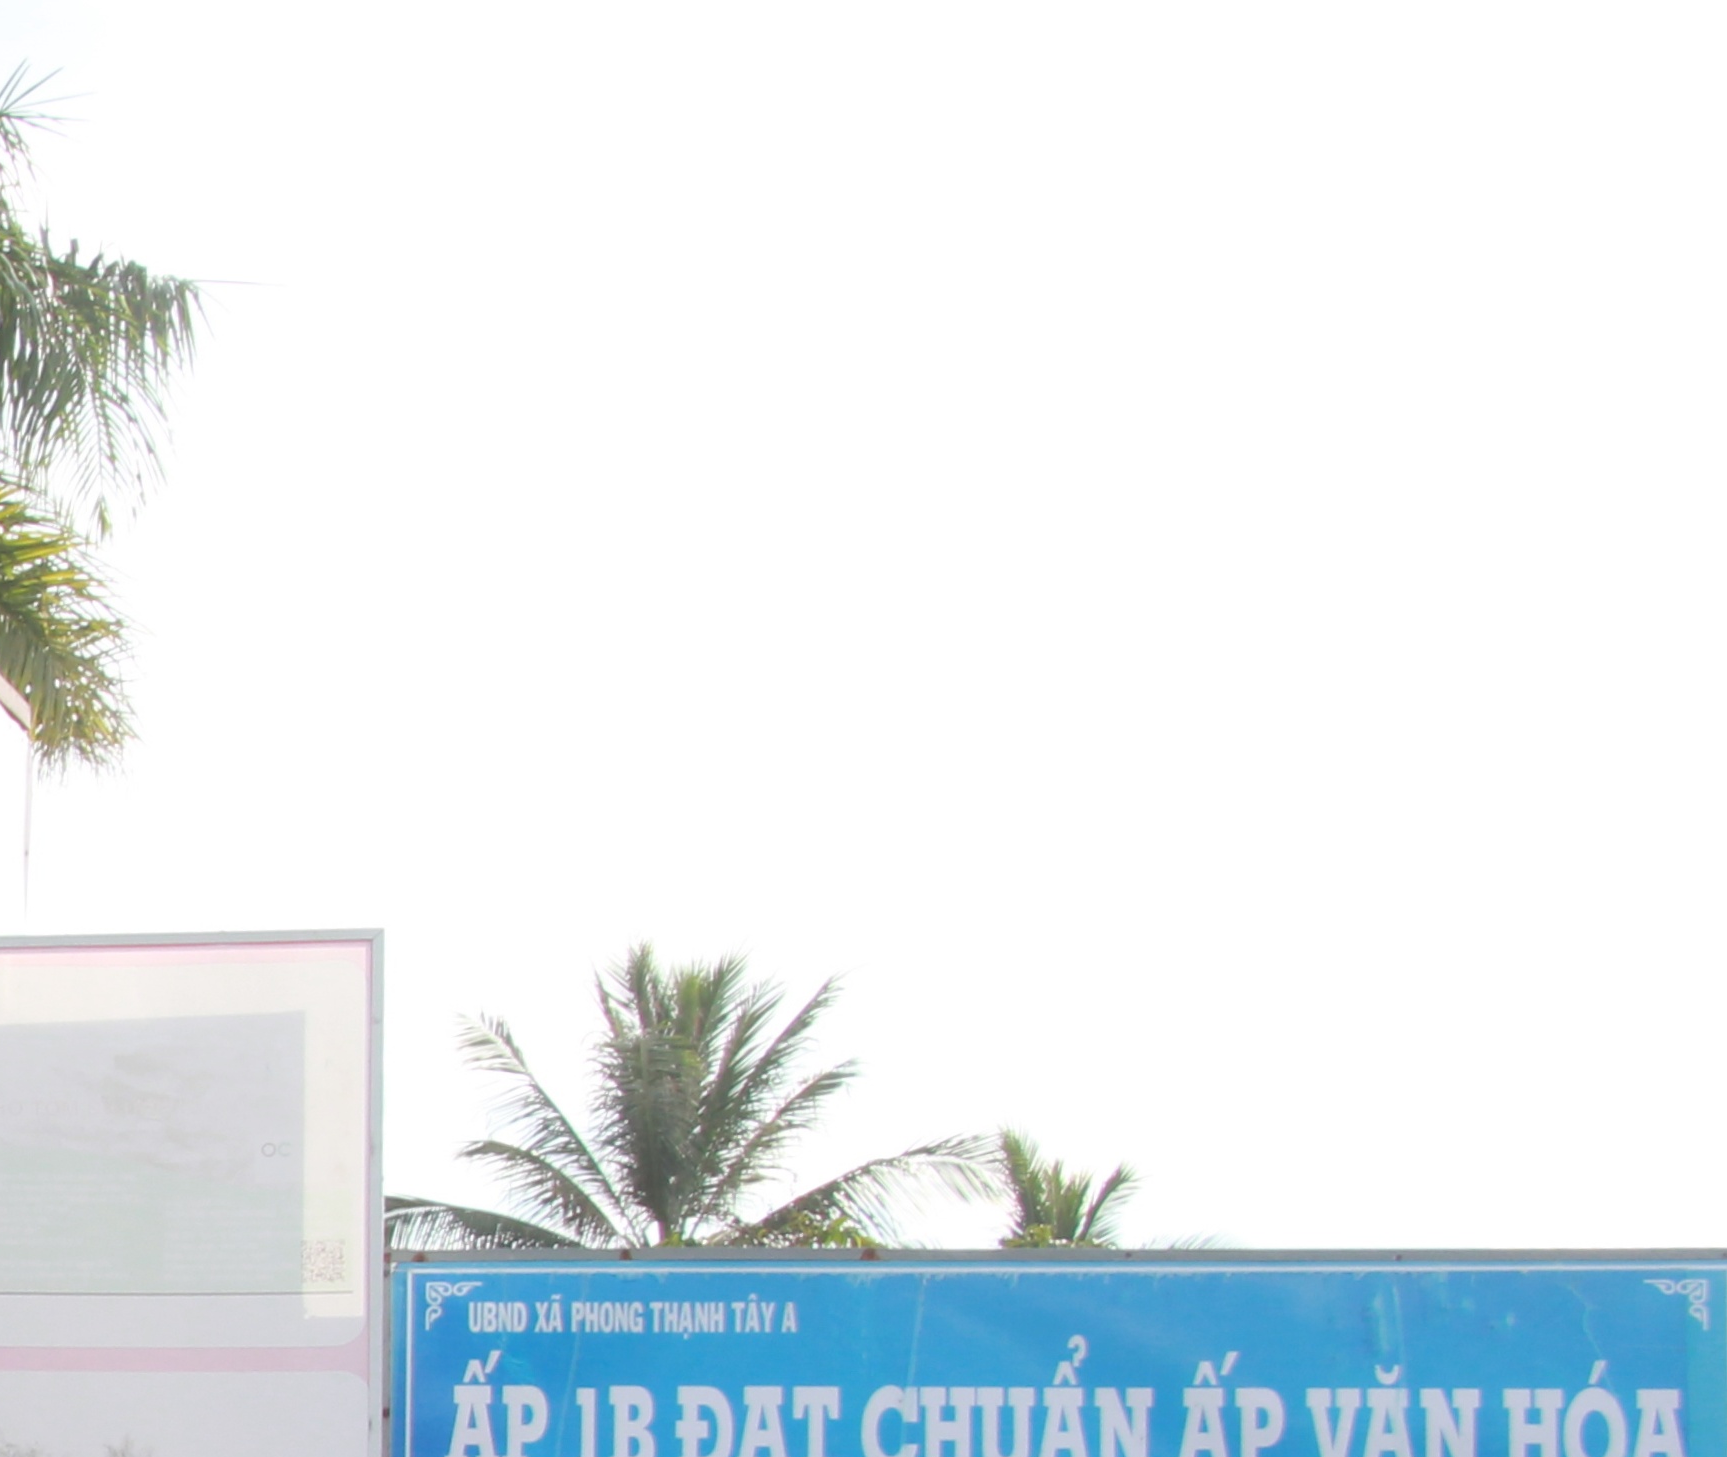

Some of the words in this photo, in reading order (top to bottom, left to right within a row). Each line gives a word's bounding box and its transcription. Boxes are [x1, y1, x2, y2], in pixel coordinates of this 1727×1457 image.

[467, 1300, 528, 1334] UBND
[534, 1293, 564, 1334] XÃ
[570, 1300, 645, 1335] PHONG
[649, 1300, 727, 1341] THẠNH
[730, 1292, 777, 1335] TÂY
[781, 1301, 799, 1335] A
